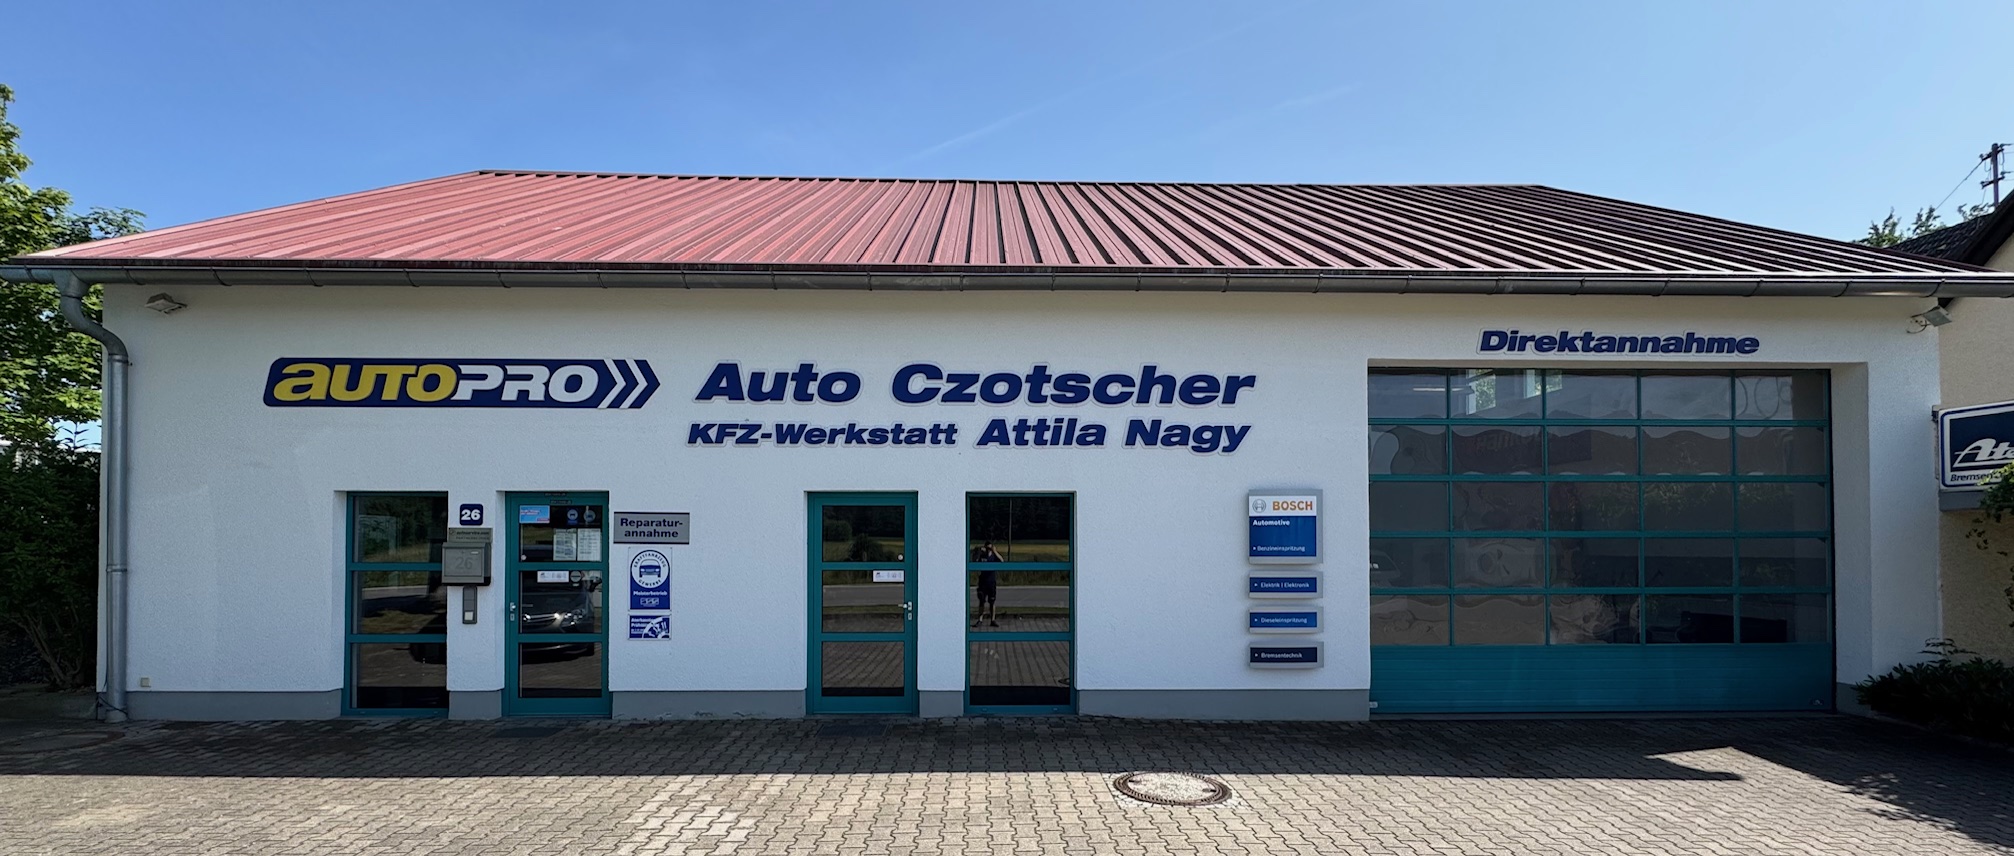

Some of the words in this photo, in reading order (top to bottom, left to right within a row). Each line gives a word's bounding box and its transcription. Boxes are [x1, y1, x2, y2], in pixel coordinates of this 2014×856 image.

[1480, 330, 1760, 354] Direktannahme
[695, 363, 861, 402] Auto
[892, 363, 1256, 405] Czotscher
[687, 423, 958, 445] KFZ-Werkstatt
[976, 418, 1107, 446] Attila
[1125, 419, 1252, 454] Nagy
[1272, 500, 1313, 511] BOSCH
[461, 509, 481, 521] 26
[620, 517, 683, 529] Reparatur-
[624, 529, 679, 538] annahme
